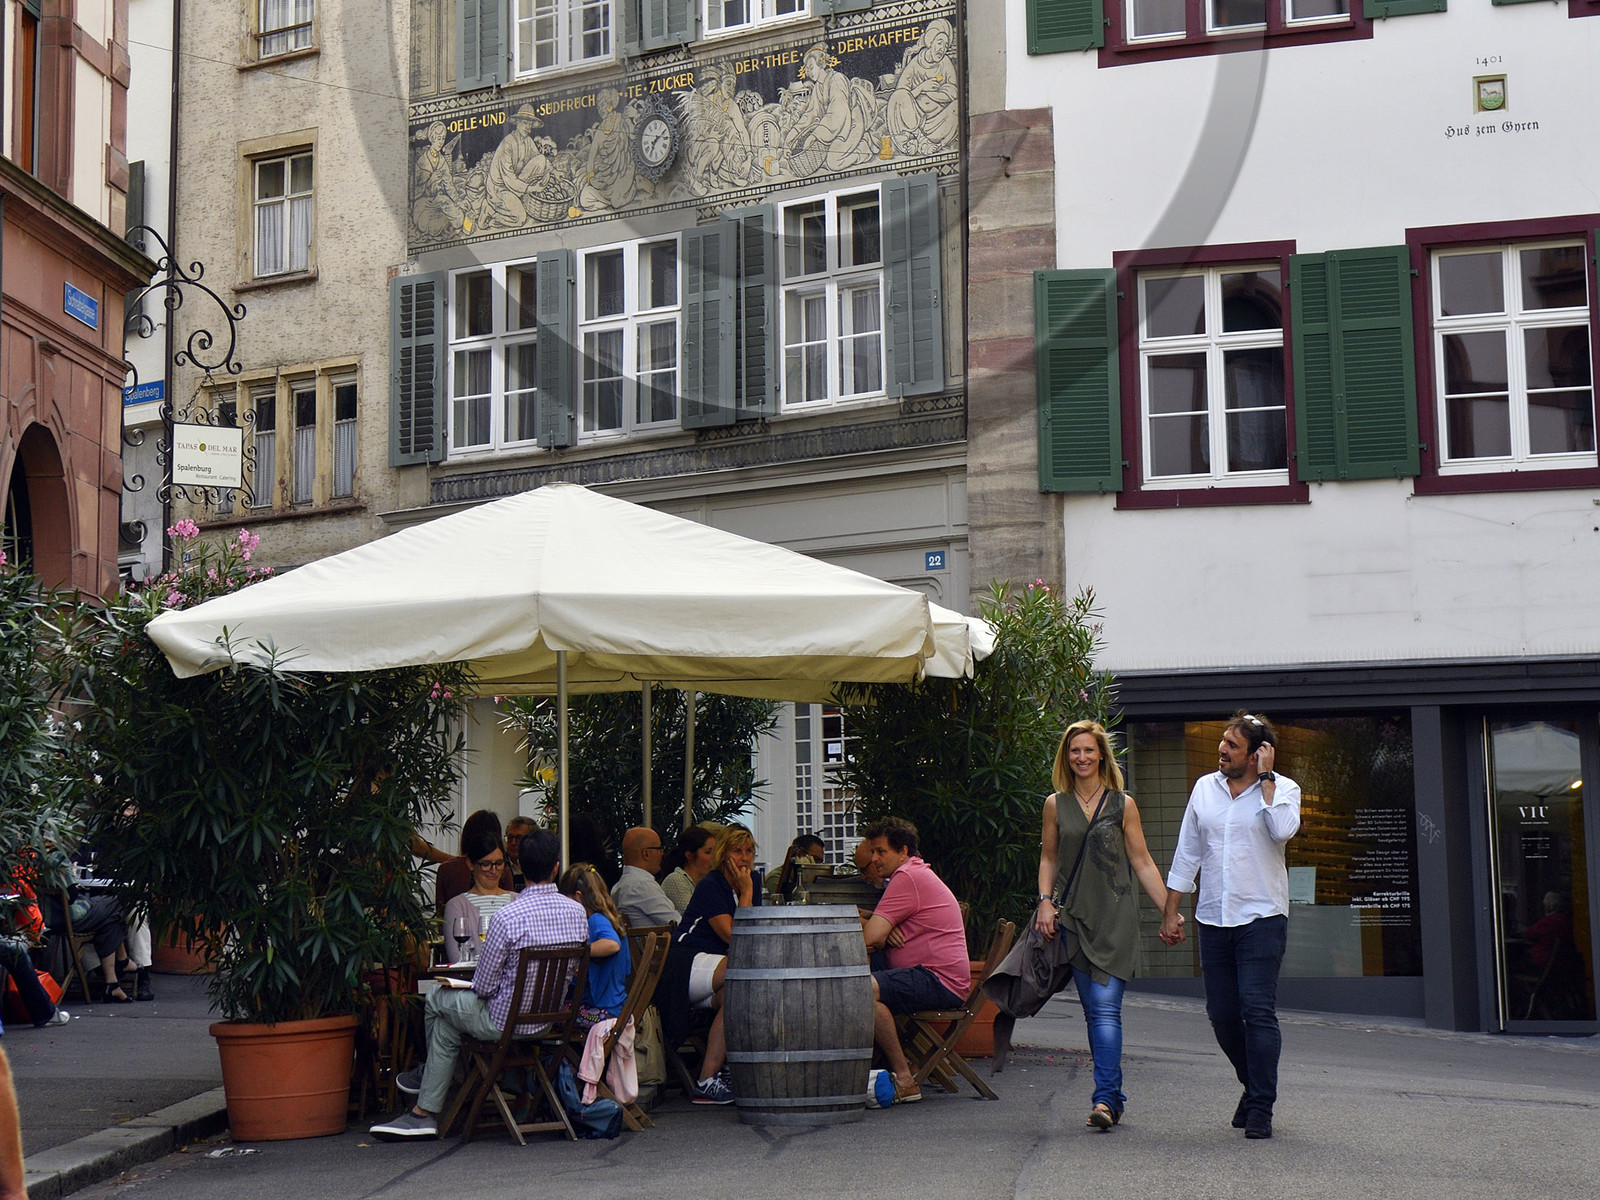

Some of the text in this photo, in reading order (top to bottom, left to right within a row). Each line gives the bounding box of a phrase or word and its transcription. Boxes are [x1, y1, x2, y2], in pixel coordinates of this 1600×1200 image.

[1476, 56, 1502, 66] 1401
[450, 118, 478, 132] OELE
[482, 112, 506, 127] UND
[649, 72, 694, 94] ZUCKER
[736, 58, 760, 75] DER
[764, 52, 800, 69] THEE
[838, 37, 864, 54] DER
[868, 26, 920, 48] KAFFEE
[177, 464, 212, 474] Spalenburg
[928, 555, 941, 566] 22
